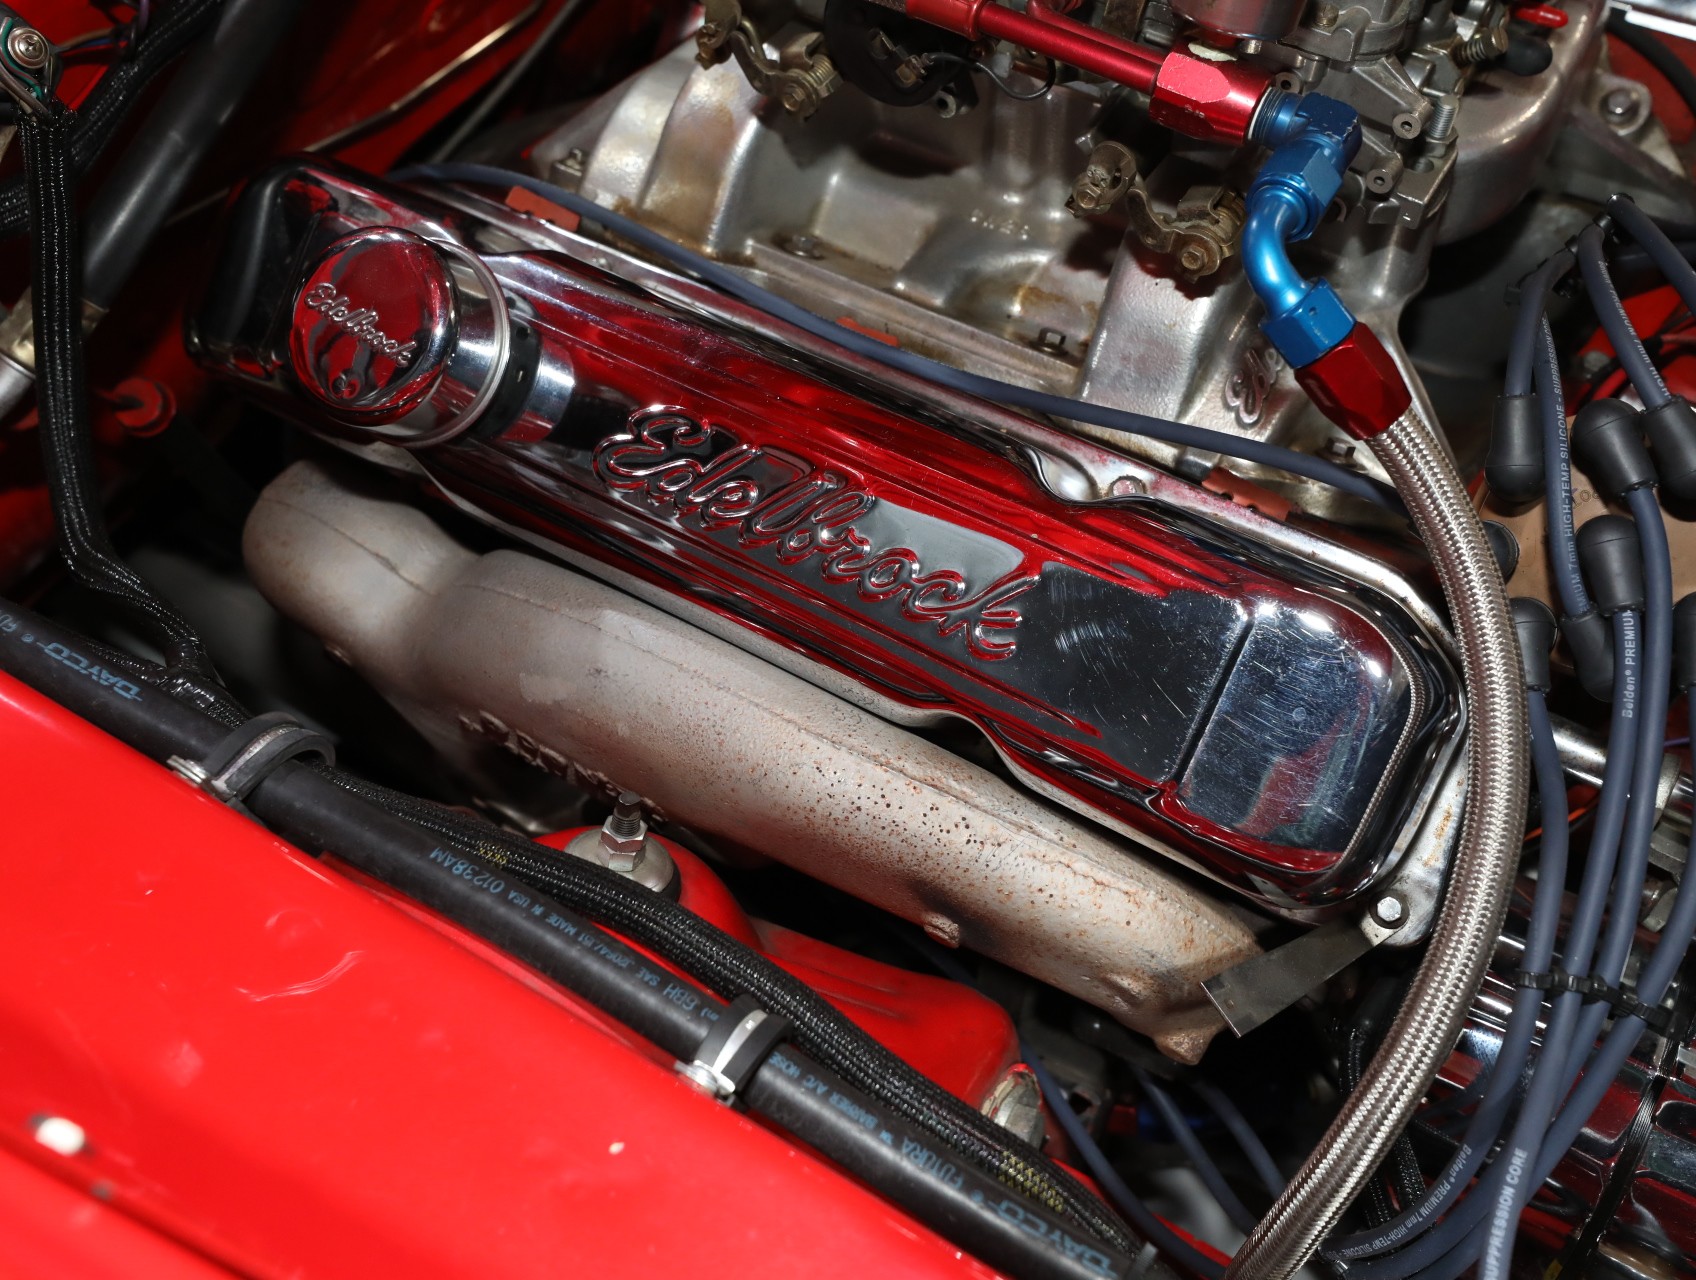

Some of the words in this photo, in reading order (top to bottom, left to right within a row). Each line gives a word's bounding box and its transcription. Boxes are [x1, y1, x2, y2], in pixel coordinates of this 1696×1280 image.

[304, 282, 418, 367] Edelbrock
[1556, 404, 1570, 459] SILICONE
[1560, 462, 1574, 537] HIGH-TEMP
[593, 403, 1041, 661] Edelbrock
[37, 642, 143, 701] DAYCO
[429, 846, 506, 895] 01238AM
[506, 888, 531, 909] USA
[544, 911, 578, 937] MADE
[634, 965, 661, 988] SAE
[768, 1051, 801, 1079] HOSE
[901, 1135, 964, 1191] FUTURA
[1419, 1180, 1452, 1219] PREMIUM
[1482, 1185, 1517, 1280] UPPRESSION
[1505, 1147, 1528, 1185] CORE
[987, 1199, 1118, 1279] DAYCO
[1372, 1224, 1408, 1251] HIGH-TEMP
